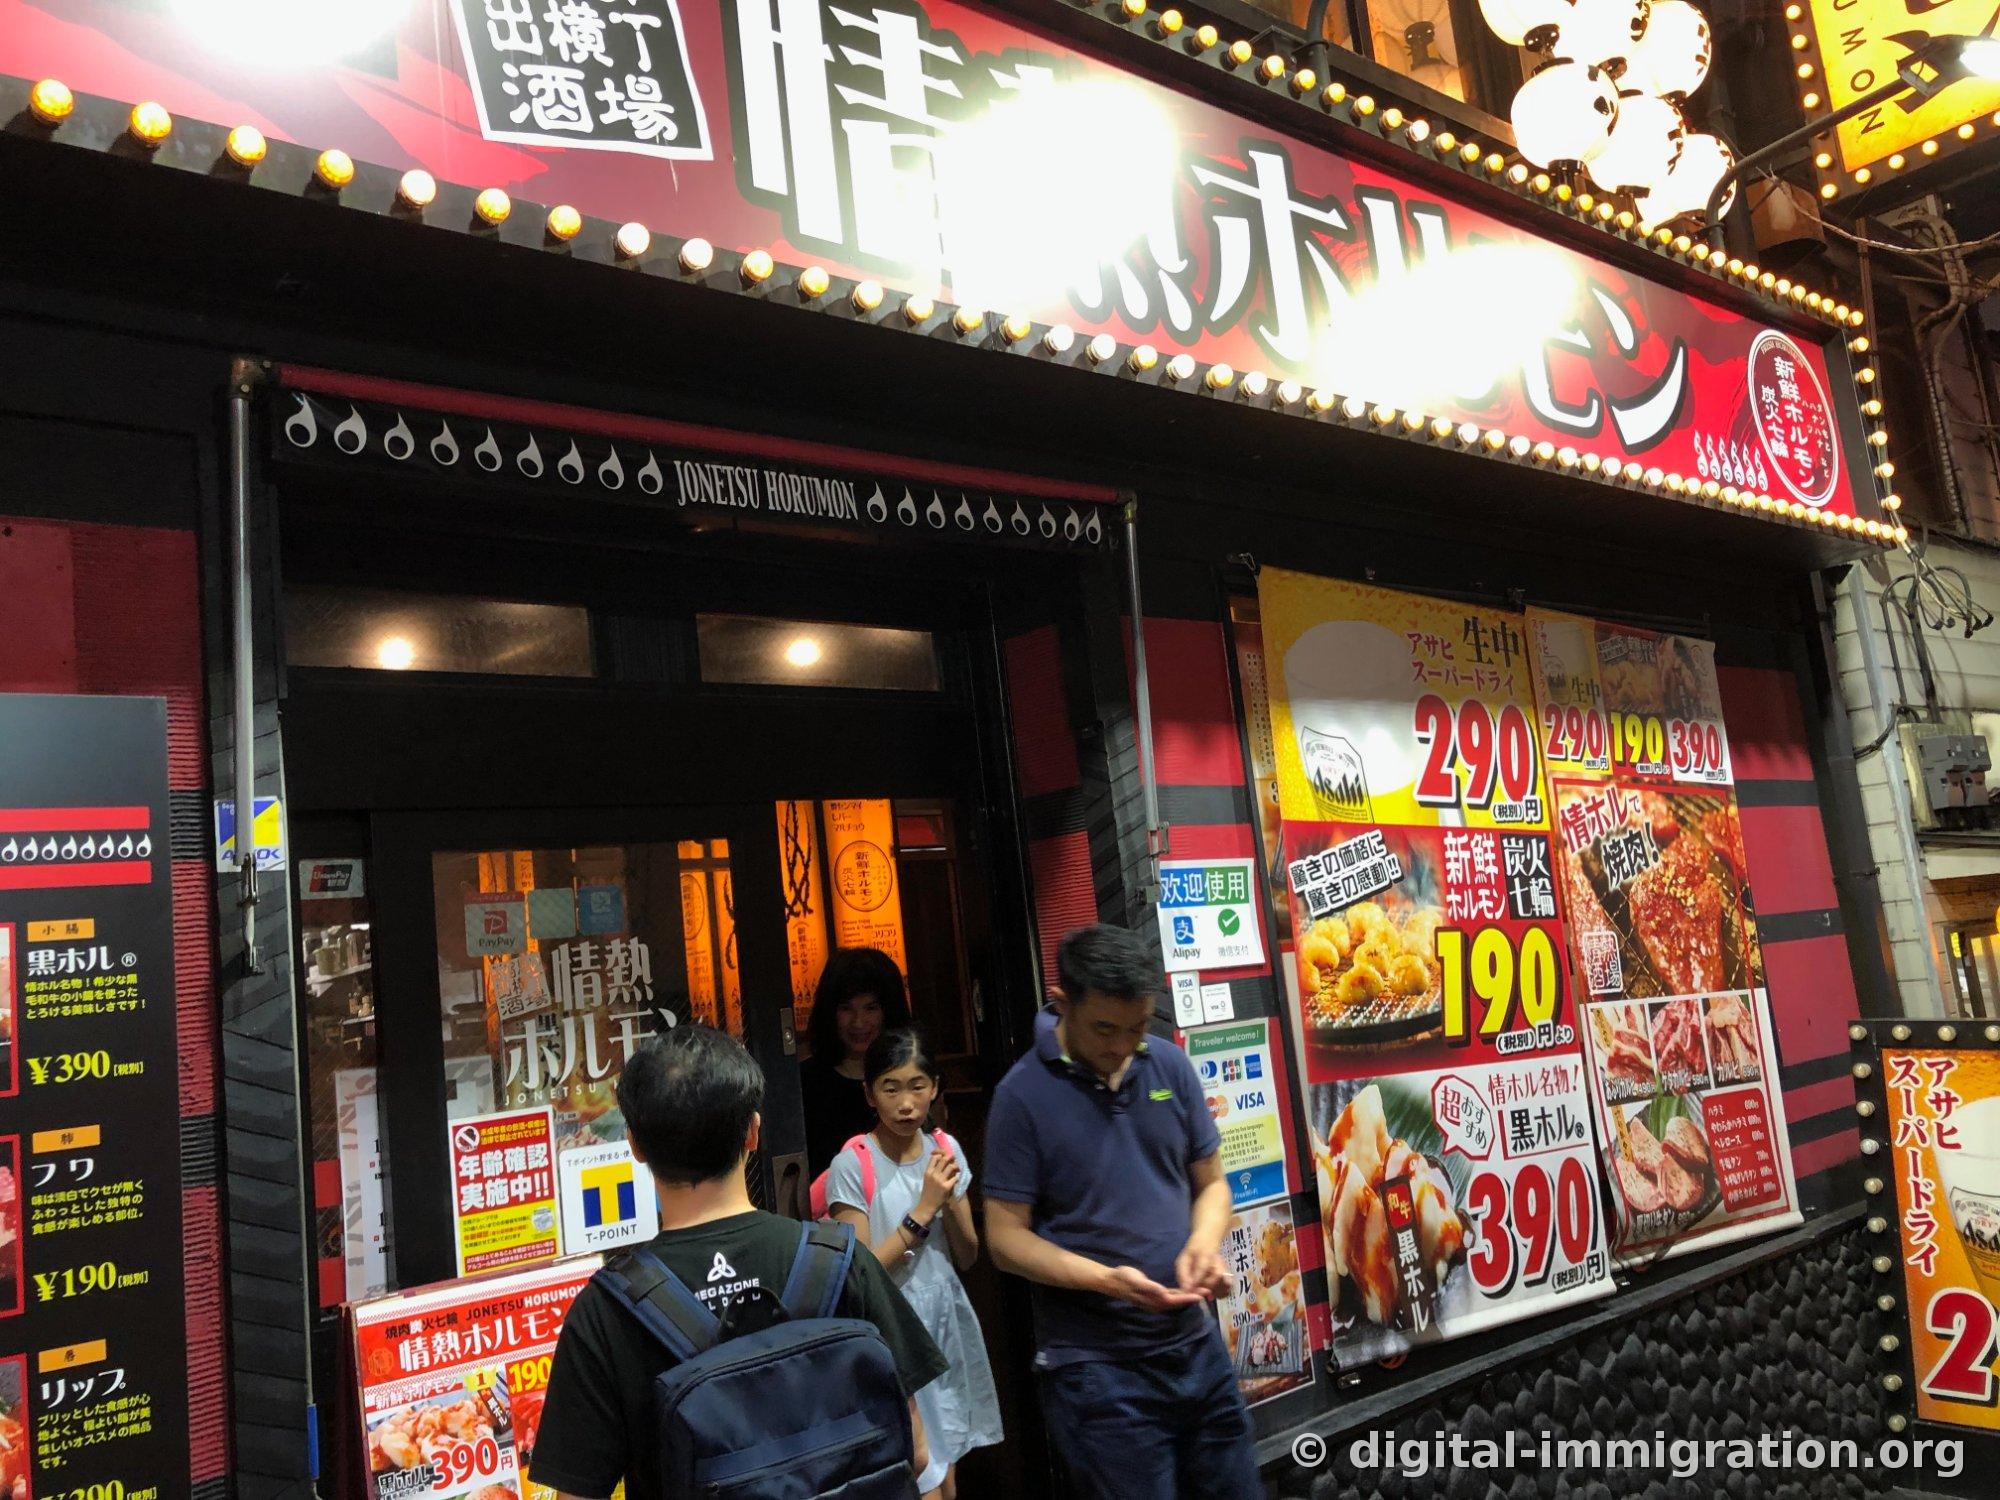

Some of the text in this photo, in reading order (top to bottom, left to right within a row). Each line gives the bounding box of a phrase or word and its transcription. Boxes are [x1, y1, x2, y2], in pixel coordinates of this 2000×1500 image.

[502, 63, 678, 142] 酒場
[1773, 355, 1816, 488] 新鮮ホルモン
[673, 459, 859, 521] JONETSU HORUMON
[1407, 631, 1455, 662] アサヒ
[1462, 615, 1520, 668] 生中
[1412, 660, 1515, 697] スーパードライ
[1414, 693, 1534, 804] 290
[1543, 703, 1604, 760] 290
[1610, 711, 1664, 764] 190
[1671, 718, 1720, 771] 390
[1600, 757, 1608, 769] 円
[1654, 761, 1662, 773] 円
[1718, 769, 1726, 781] 円
[1313, 765, 1365, 808] Asahi
[1493, 799, 1541, 820] (税別) 円
[1560, 787, 1642, 852] 情ホルで
[221, 848, 280, 860] AOK
[1290, 833, 1385, 889] 驚きの価格に
[1443, 832, 1499, 886] 新鮮
[1502, 836, 1549, 877] 炭火
[1602, 821, 1661, 886] 焼肉!
[855, 851, 873, 906] 新鮮ホルモン
[1160, 871, 1245, 905] 欢迎使用
[1307, 857, 1400, 912] 驚きの感動!!
[1446, 888, 1506, 922] ホルモン
[1509, 878, 1556, 918] 七輪
[478, 936, 516, 949] PayPay
[1172, 947, 1201, 960] Alipay
[551, 936, 654, 1013] 情熱
[1177, 979, 1193, 989] VISA
[1437, 926, 1557, 1038] 190
[1194, 1030, 1260, 1048] Traveler welcome!
[1497, 1025, 1573, 1052] (税別) 円 より
[1487, 1064, 1580, 1106] 情ホル名物!
[1717, 1062, 1740, 1082] カルビ
[504, 1082, 597, 1106] JONETSU
[1235, 1091, 1266, 1111] VISA
[1440, 1086, 1462, 1127] 超
[1708, 1105, 1724, 1117] ハラミ
[1925, 1059, 1962, 1151] アサヒ
[31, 1158, 95, 1188] フワ
[458, 1143, 550, 1180] 年齢確認
[1892, 1056, 1938, 1276] スーパードライ
[31, 1193, 144, 1221] ふわっとした独特の
[1387, 1191, 1411, 1219] 和牛
[1468, 1156, 1591, 1289] 390
[586, 1223, 638, 1244] T-POINT
[1231, 1228, 1253, 1297] 黒ホル
[1552, 1254, 1605, 1289] (税別) 円
[1397, 1229, 1431, 1336] 黒ホル
[385, 1311, 459, 1340] 焼肉炭火七輪
[1232, 1310, 1251, 1329] 390
[41, 1367, 127, 1409] リップ
[37, 1424, 152, 1456] 味しいオススメの商品
[378, 1464, 430, 1495] 黒ホル
[430, 1436, 514, 1492] 390 円
[40, 1479, 125, 1500] 390
